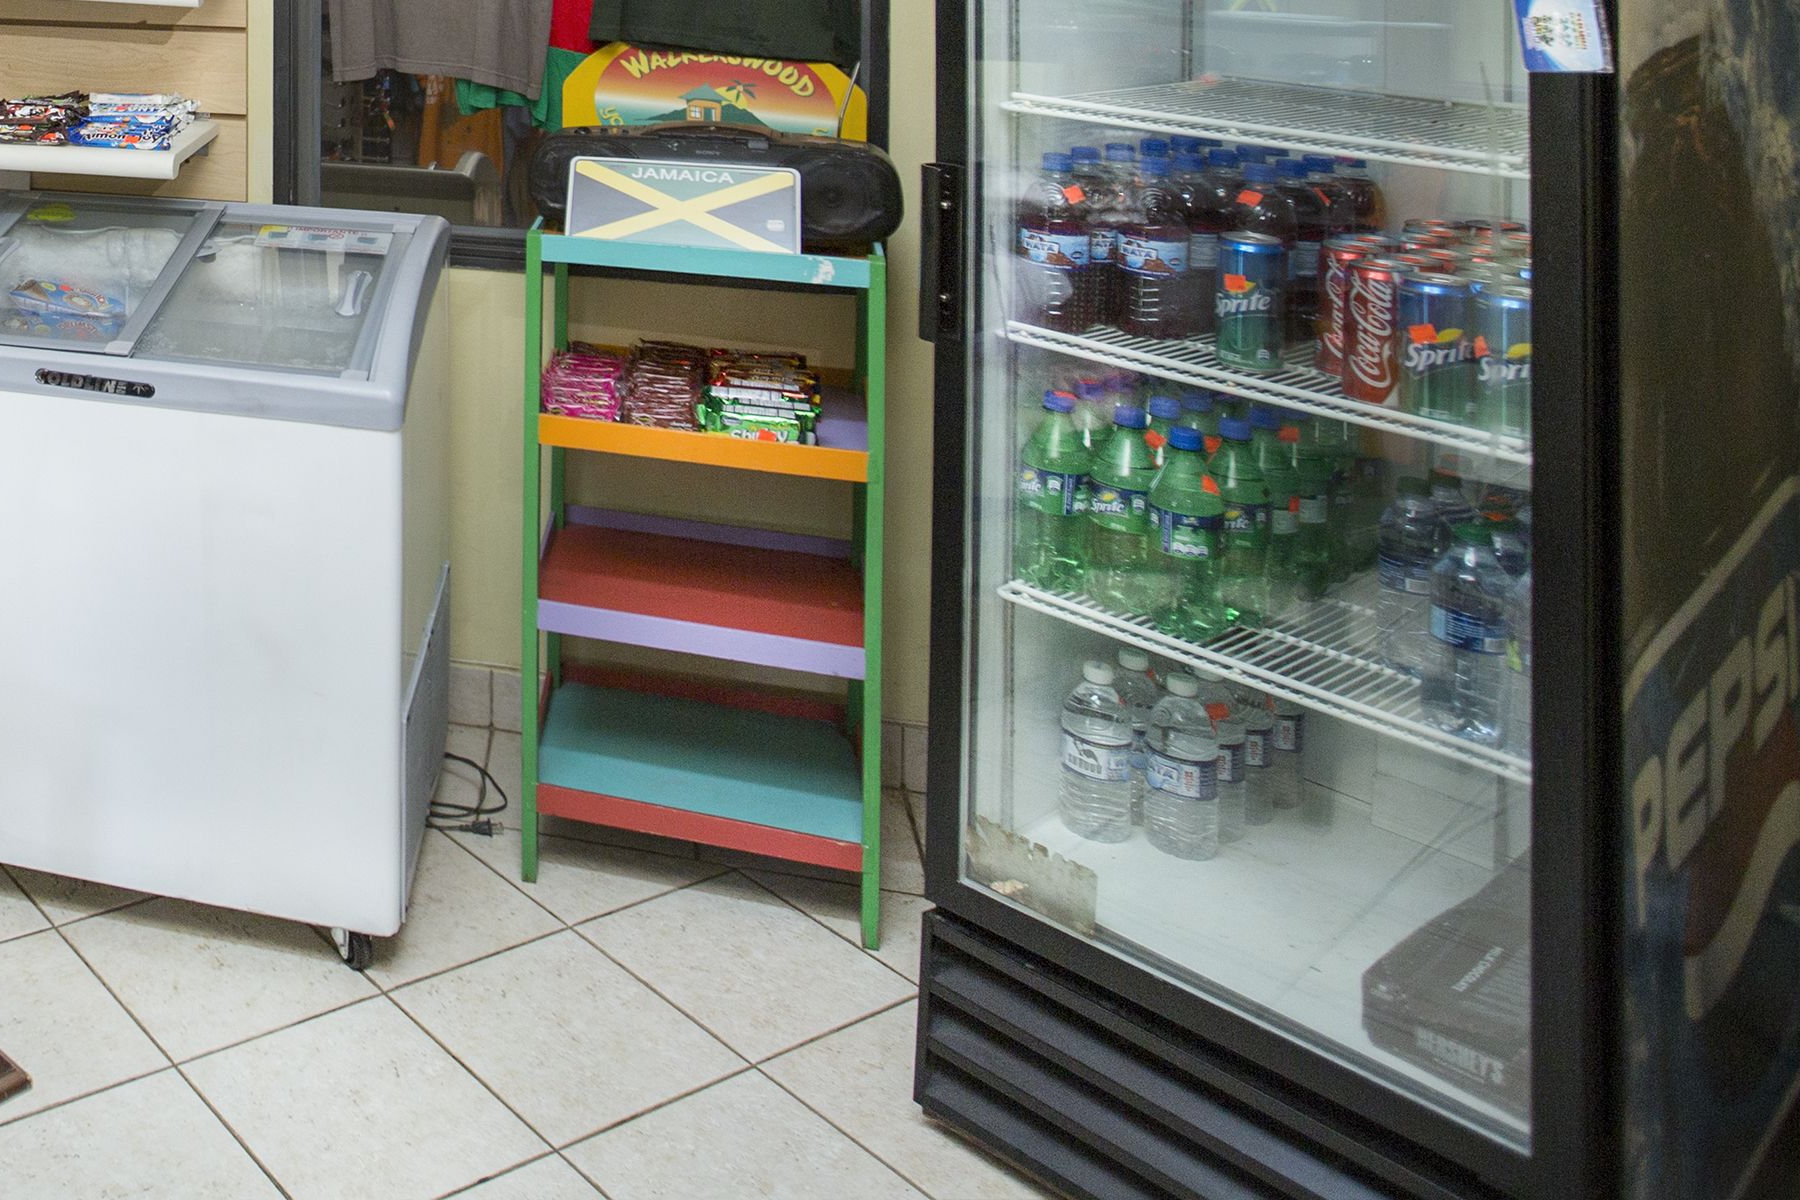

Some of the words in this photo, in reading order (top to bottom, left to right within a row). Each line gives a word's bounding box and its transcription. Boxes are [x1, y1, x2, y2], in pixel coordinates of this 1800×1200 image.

[632, 166, 735, 185] JAMAICA
[1216, 292, 1271, 317] Sprite
[1350, 270, 1394, 388] Coca-Cola
